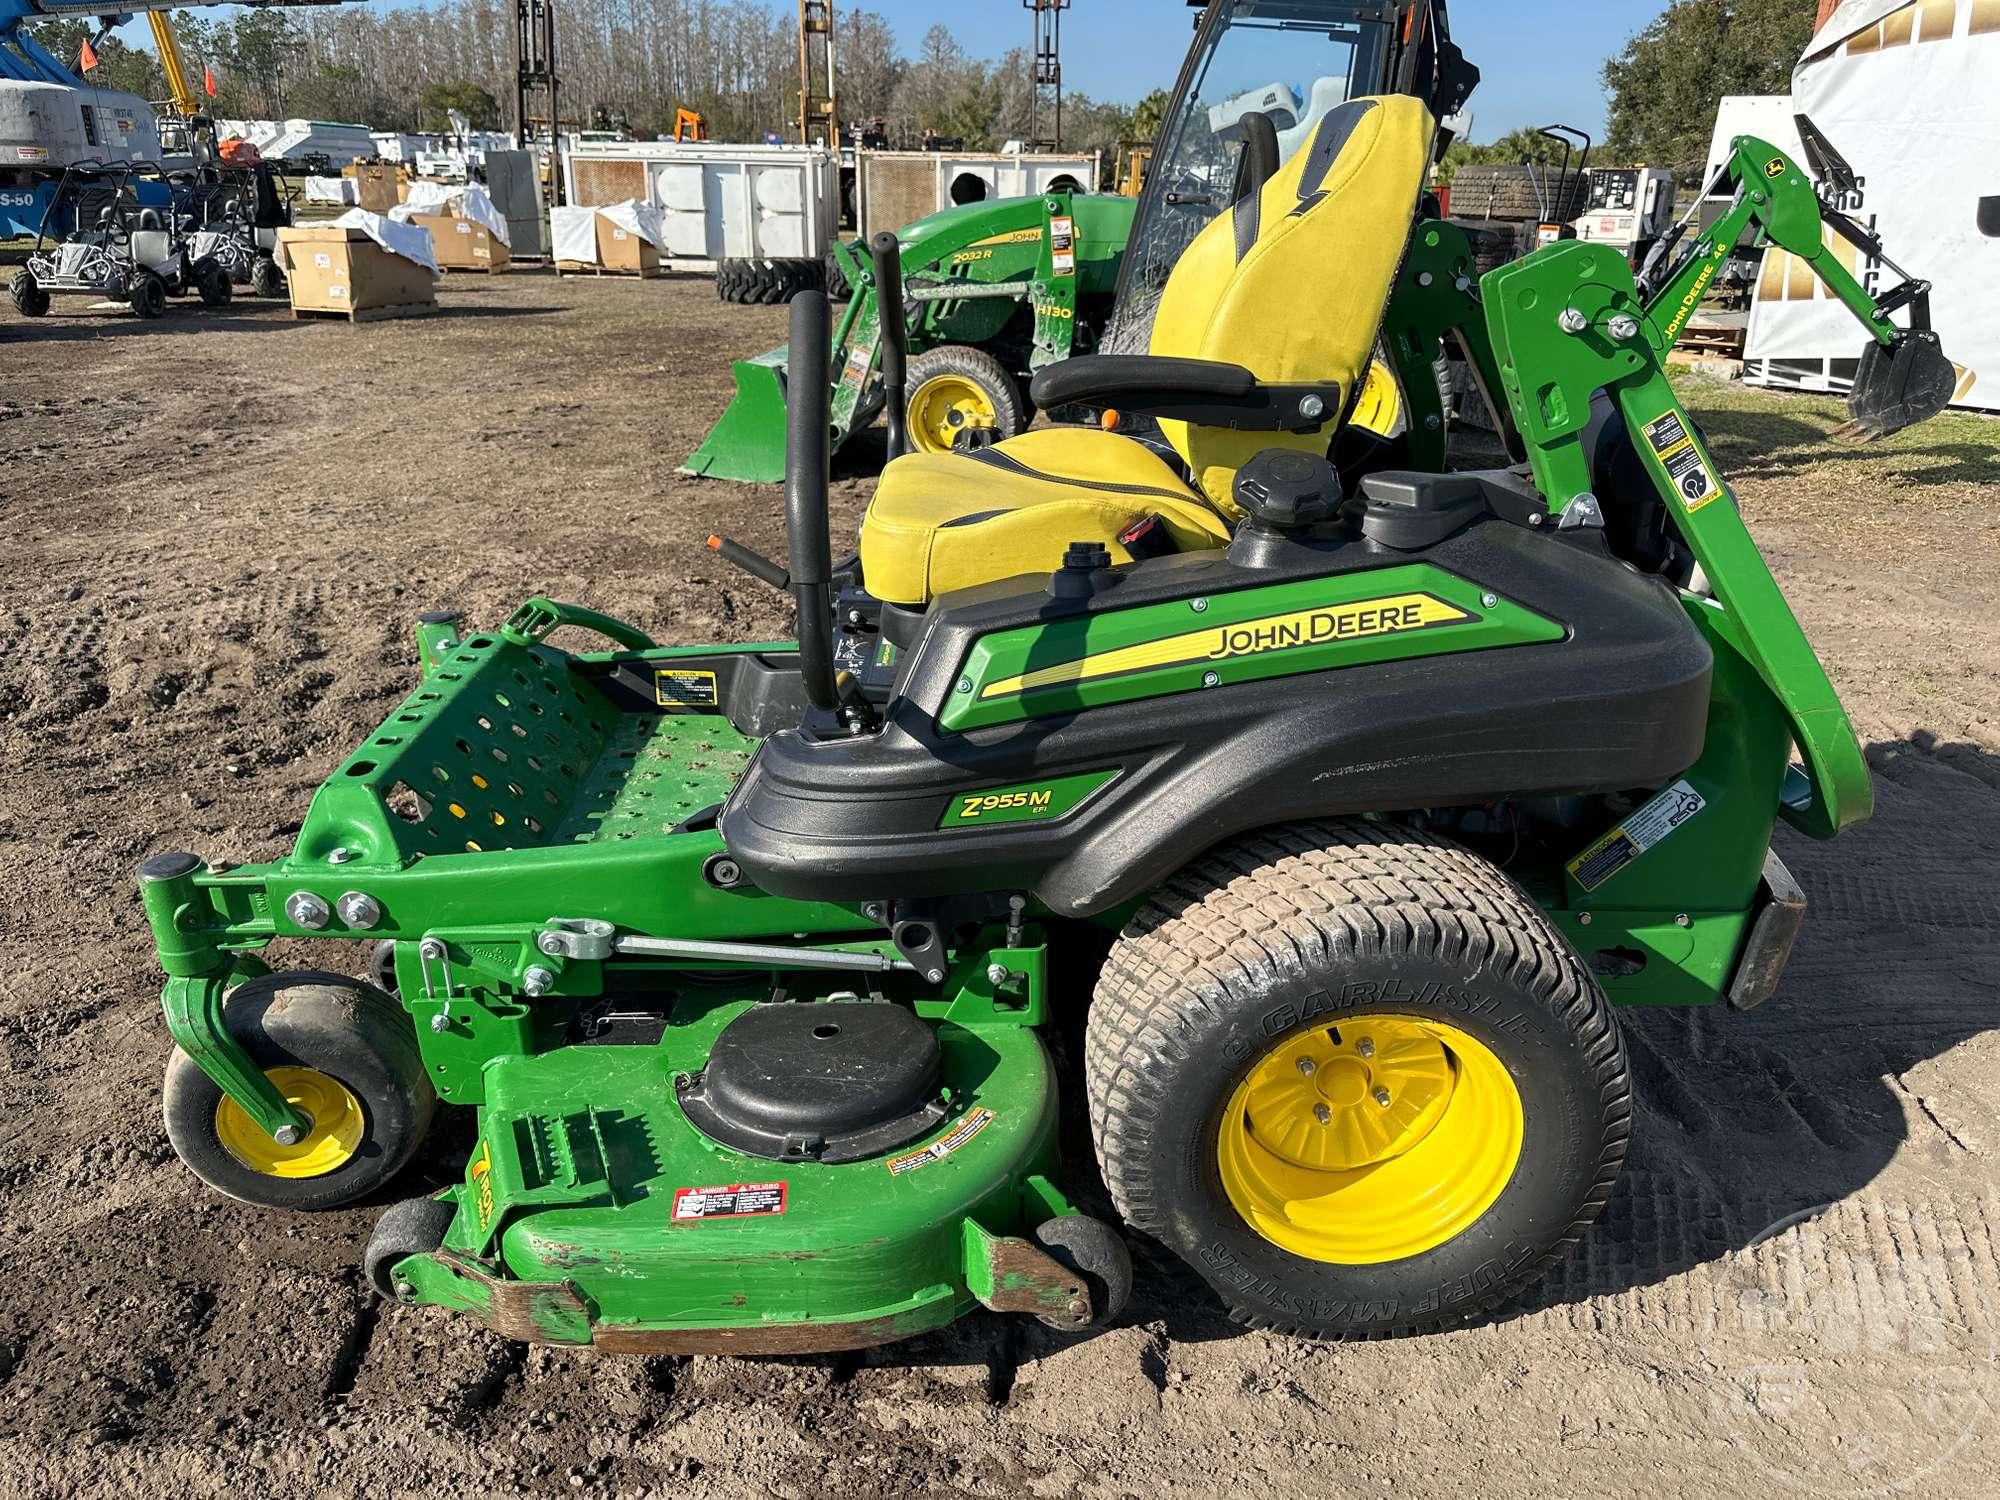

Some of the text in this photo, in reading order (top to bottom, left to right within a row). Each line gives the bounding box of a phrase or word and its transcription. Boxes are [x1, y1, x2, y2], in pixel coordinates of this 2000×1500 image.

[1009, 232, 1040, 243] JOHN
[1664, 305, 1689, 340] JOHN
[1682, 263, 1714, 307] DEERE
[1037, 304, 1072, 319] H130
[1209, 603, 1423, 656] JOHN DEERE
[699, 1183, 780, 1195] DANGER PELIGRO
